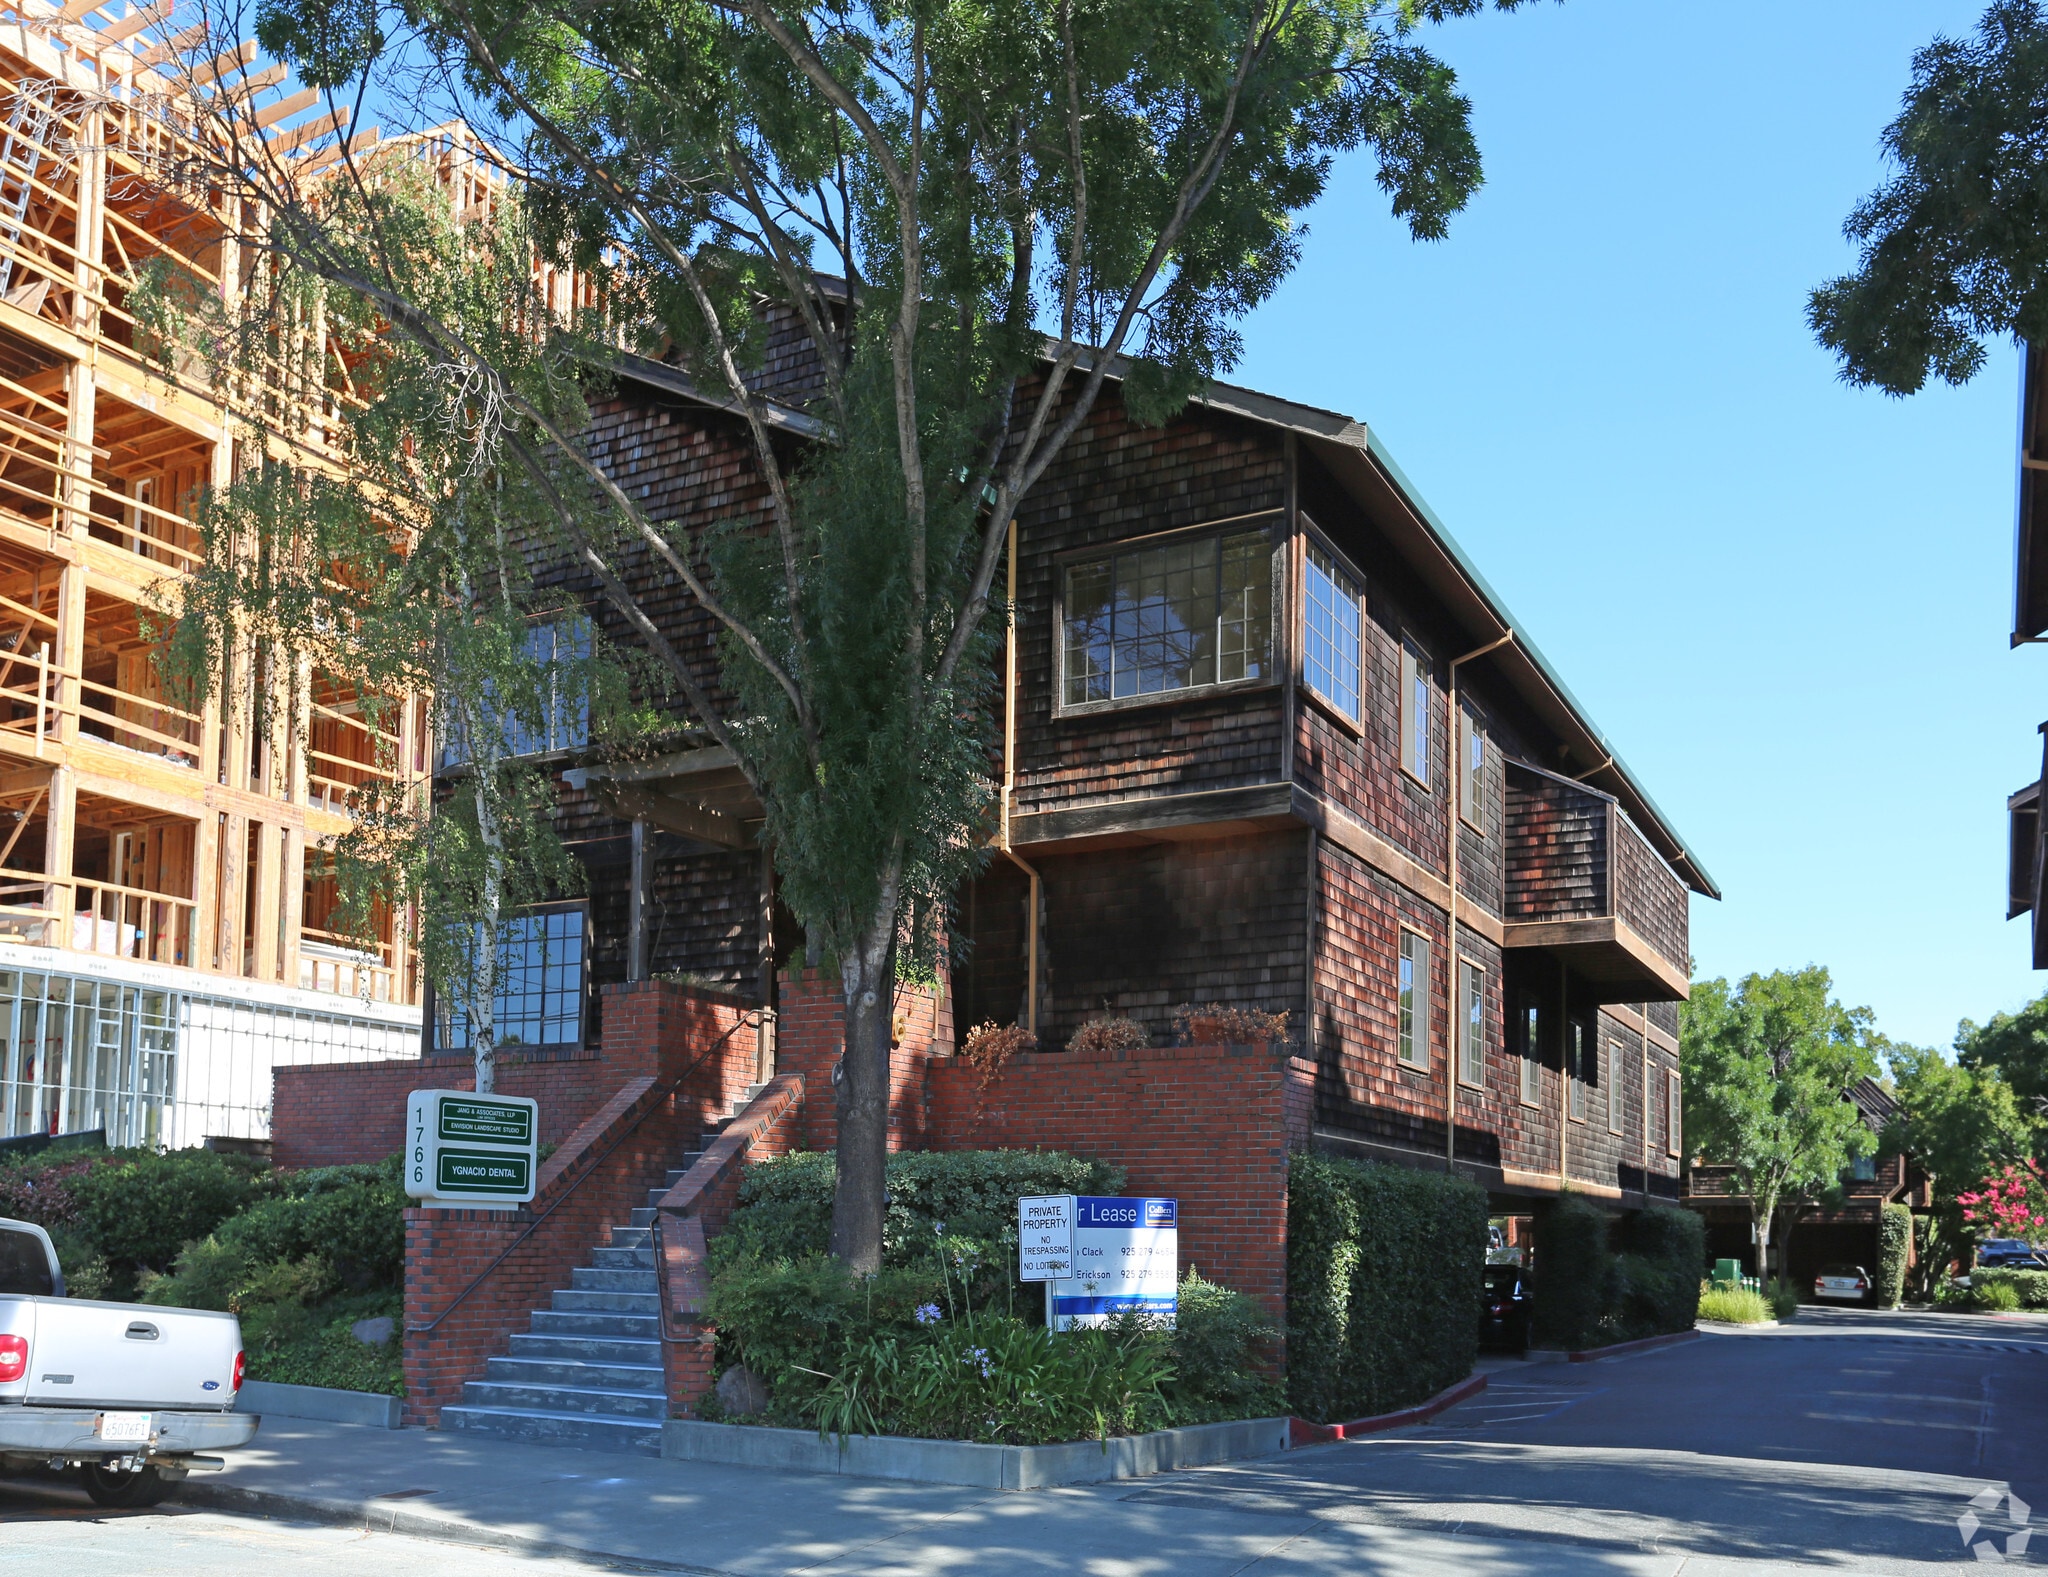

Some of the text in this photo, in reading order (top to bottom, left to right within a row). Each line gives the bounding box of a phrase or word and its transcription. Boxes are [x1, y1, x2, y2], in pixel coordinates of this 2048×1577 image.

[451, 1122, 520, 1134] ENVISION LANDSCAPE STUDIO
[413, 1107, 424, 1183] 1766
[452, 1165, 516, 1178] YGNACIO DENTAL
[1028, 1206, 1061, 1217] PRIVATE
[1091, 1203, 1137, 1222] Lease
[1148, 1205, 1172, 1214] Colliers
[1023, 1218, 1067, 1229] PROPERTY
[1041, 1236, 1051, 1244] NO
[1024, 1246, 1069, 1256] TRESPASSING
[1082, 1247, 1104, 1256] Clack
[1120, 1247, 1136, 1256] 925
[1076, 1270, 1111, 1279] Erickson
[1120, 1270, 1136, 1279] 925
[1138, 1270, 1153, 1279] 279
